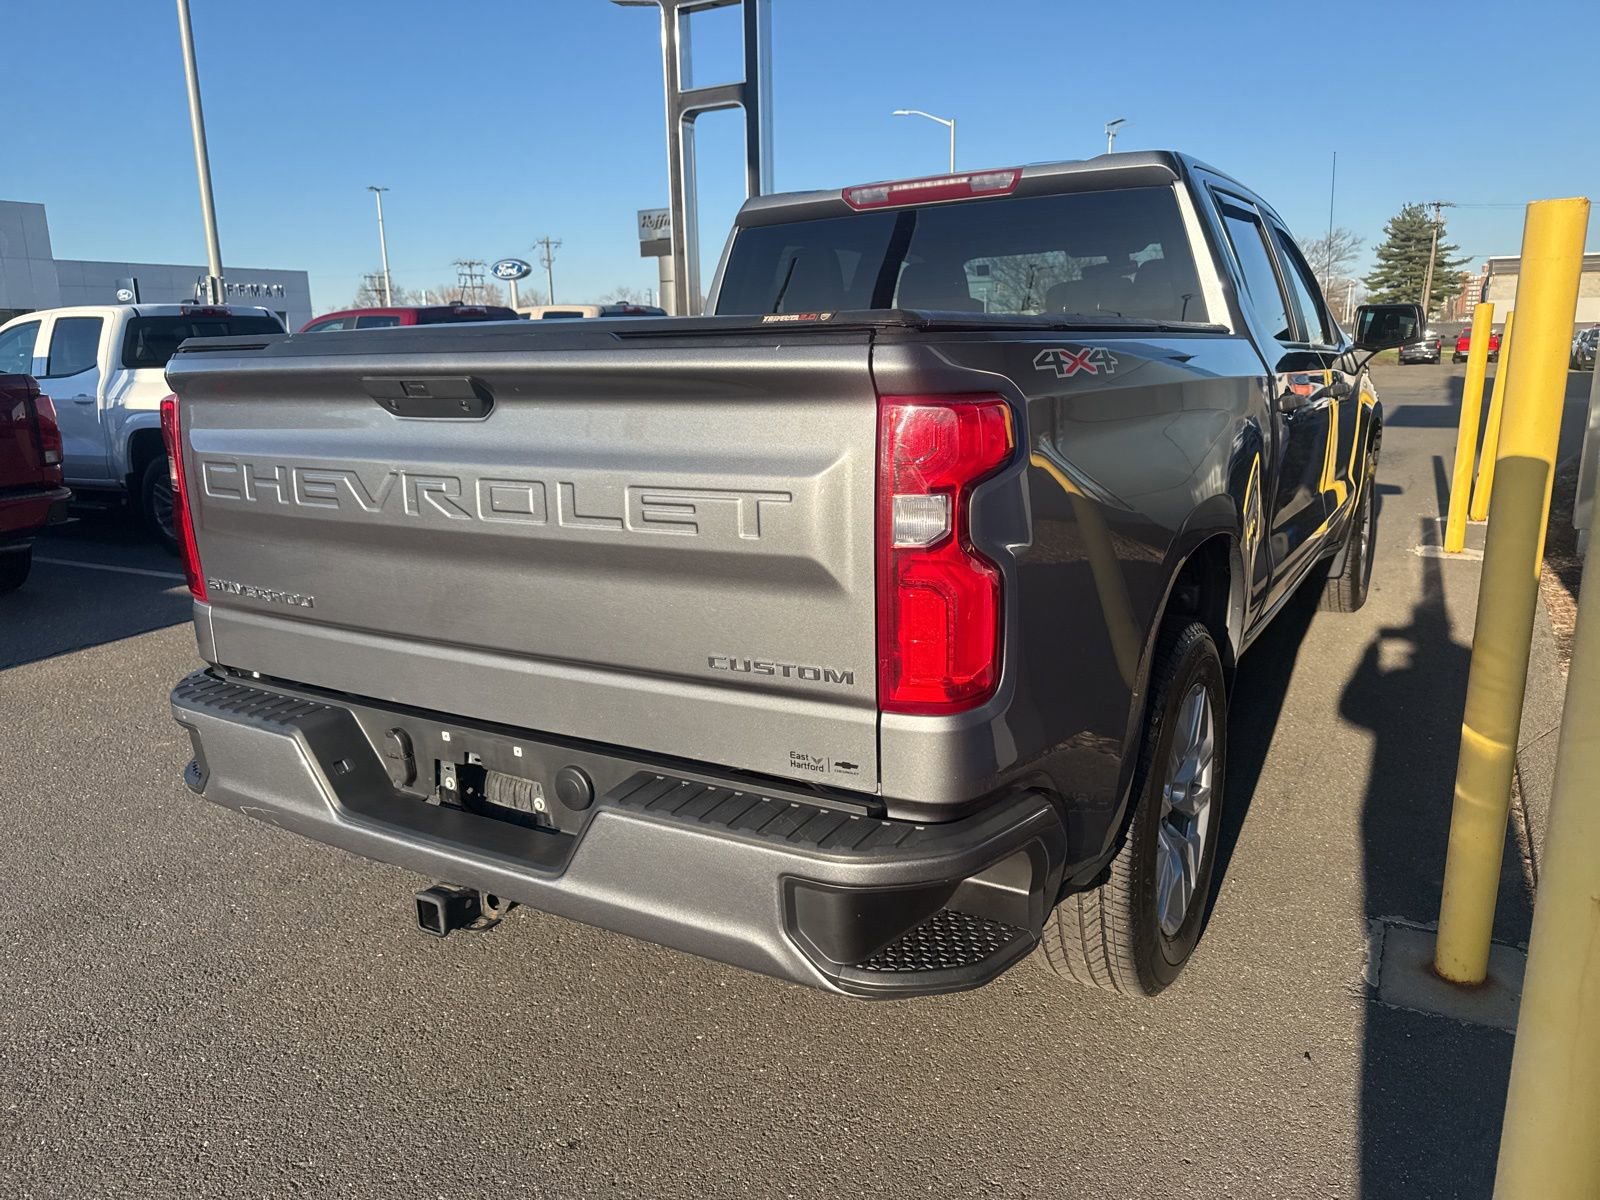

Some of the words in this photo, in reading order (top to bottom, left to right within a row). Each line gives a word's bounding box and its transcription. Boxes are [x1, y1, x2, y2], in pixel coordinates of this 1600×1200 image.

[496, 262, 519, 276] Ford
[195, 283, 286, 298] HFFMAN
[202, 461, 793, 540] CHEVROLET
[708, 656, 854, 685] CUSTOM
[789, 751, 809, 761] East
[790, 759, 824, 773] Hartford
